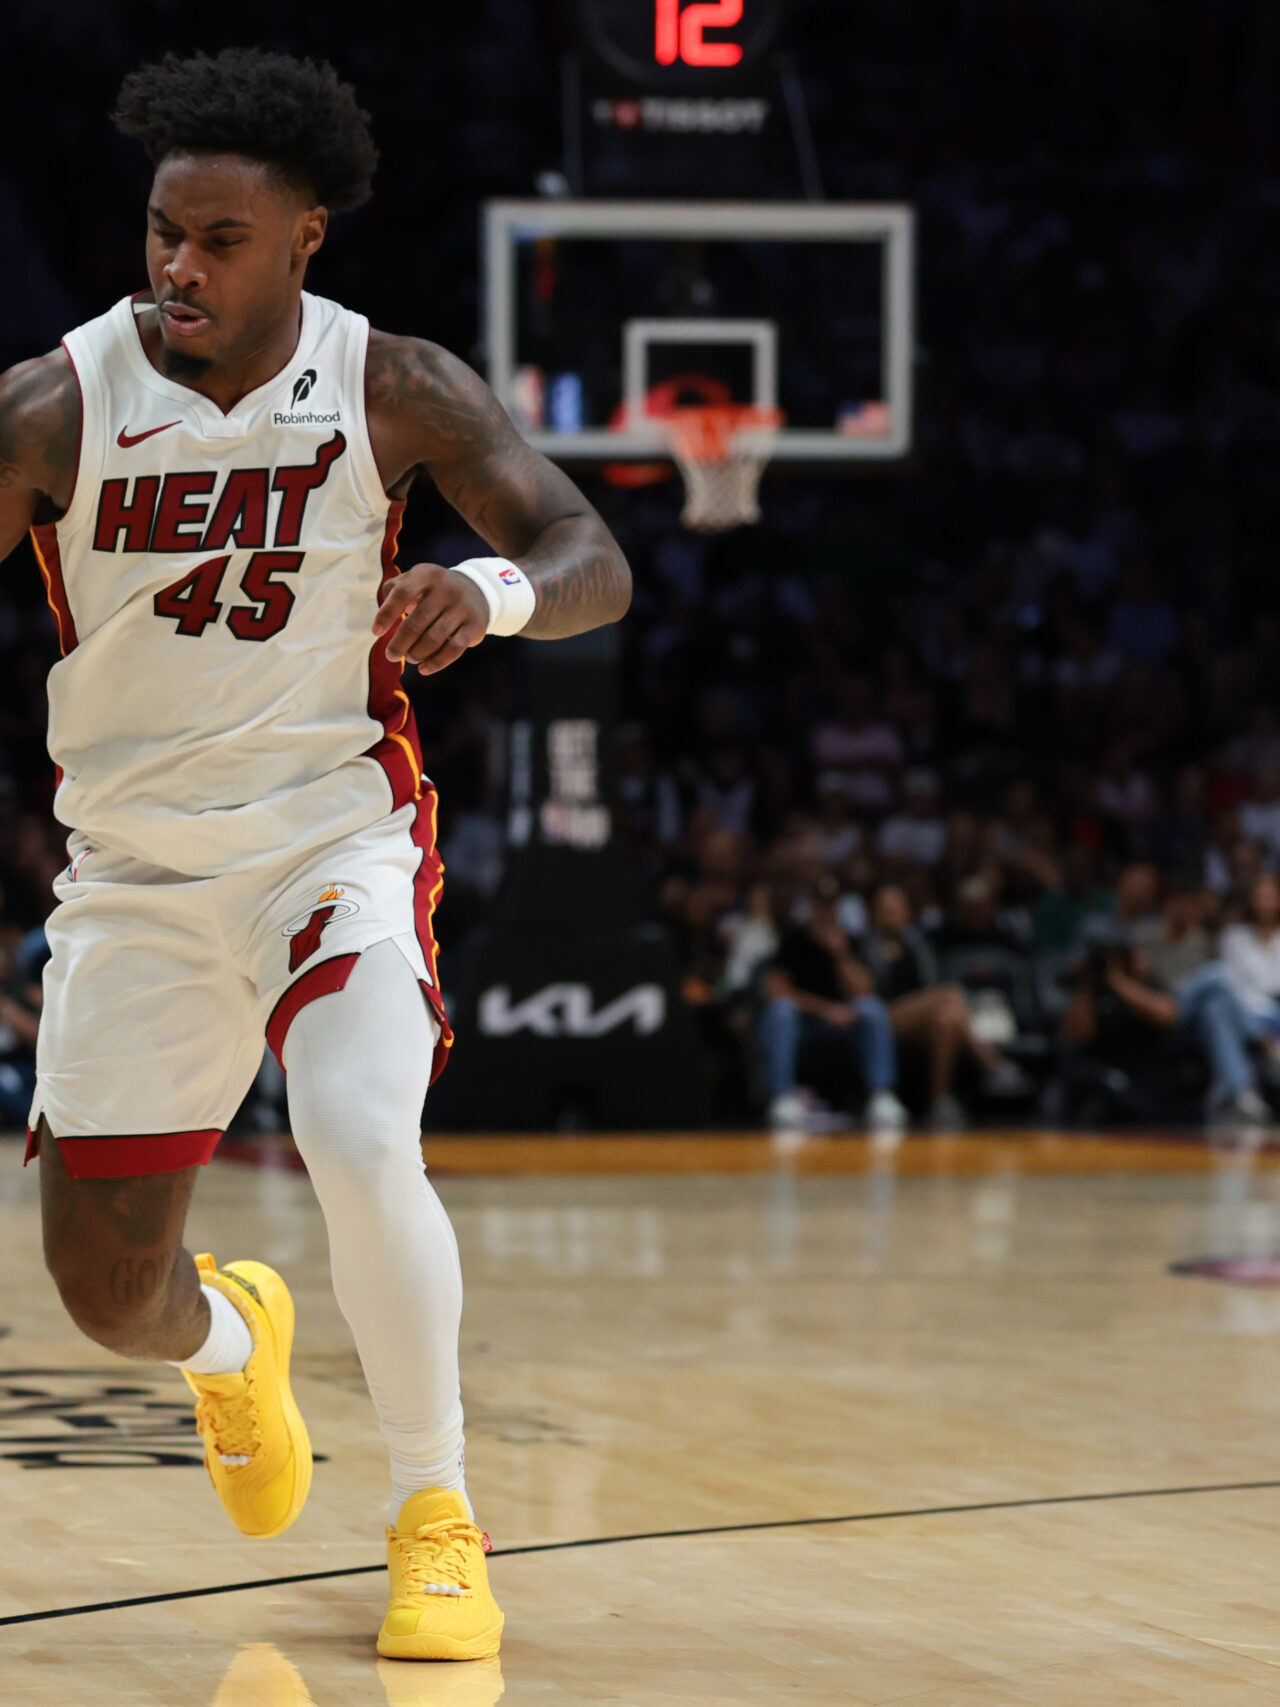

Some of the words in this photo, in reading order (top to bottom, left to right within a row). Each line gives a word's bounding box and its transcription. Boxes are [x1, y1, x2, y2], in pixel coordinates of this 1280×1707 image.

[655, 0, 744, 67] 12
[273, 410, 342, 426] Robinhood
[92, 429, 347, 553] HEAT
[154, 551, 306, 642] 45
